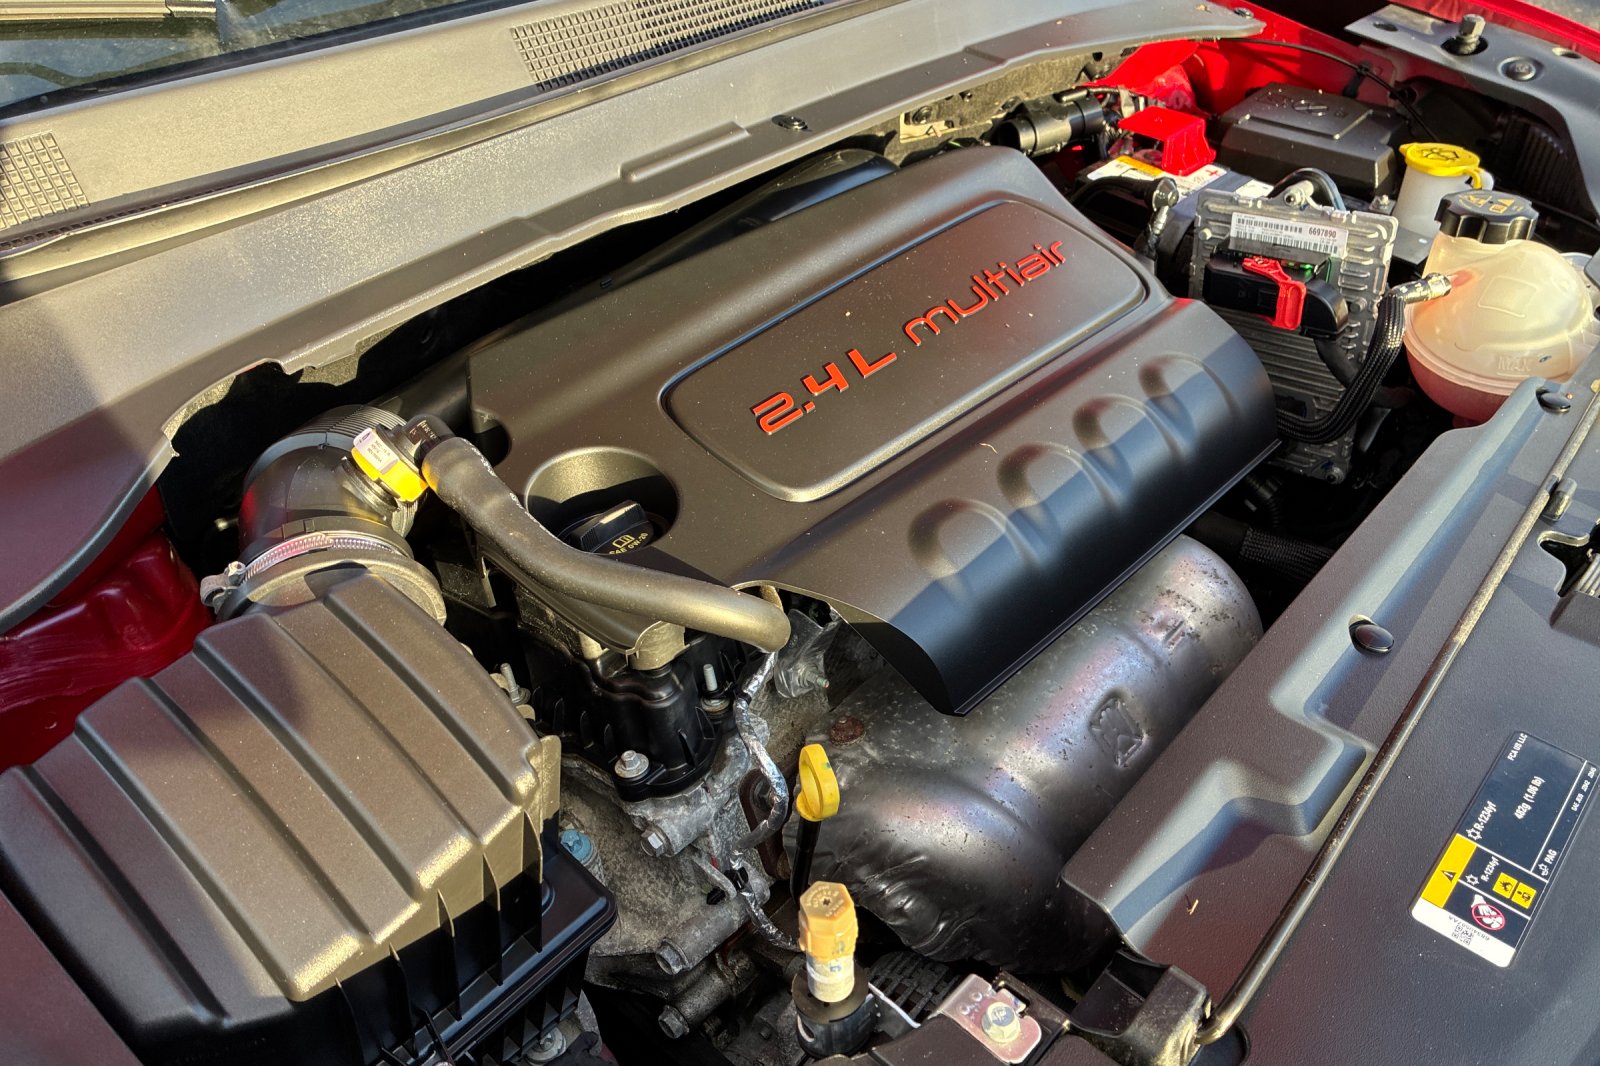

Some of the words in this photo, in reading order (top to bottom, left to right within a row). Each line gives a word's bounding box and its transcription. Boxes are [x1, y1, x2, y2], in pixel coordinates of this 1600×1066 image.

[1308, 227, 1337, 239] 6697890
[904, 241, 1066, 347] multiair
[1507, 749, 1517, 761] FCA
[1517, 732, 1528, 744] LLC
[1473, 800, 1497, 832] R-1234yf
[1513, 802, 1532, 820] 482g
[1480, 856, 1499, 882] R-1234yf
[1544, 849, 1557, 865] PAG
